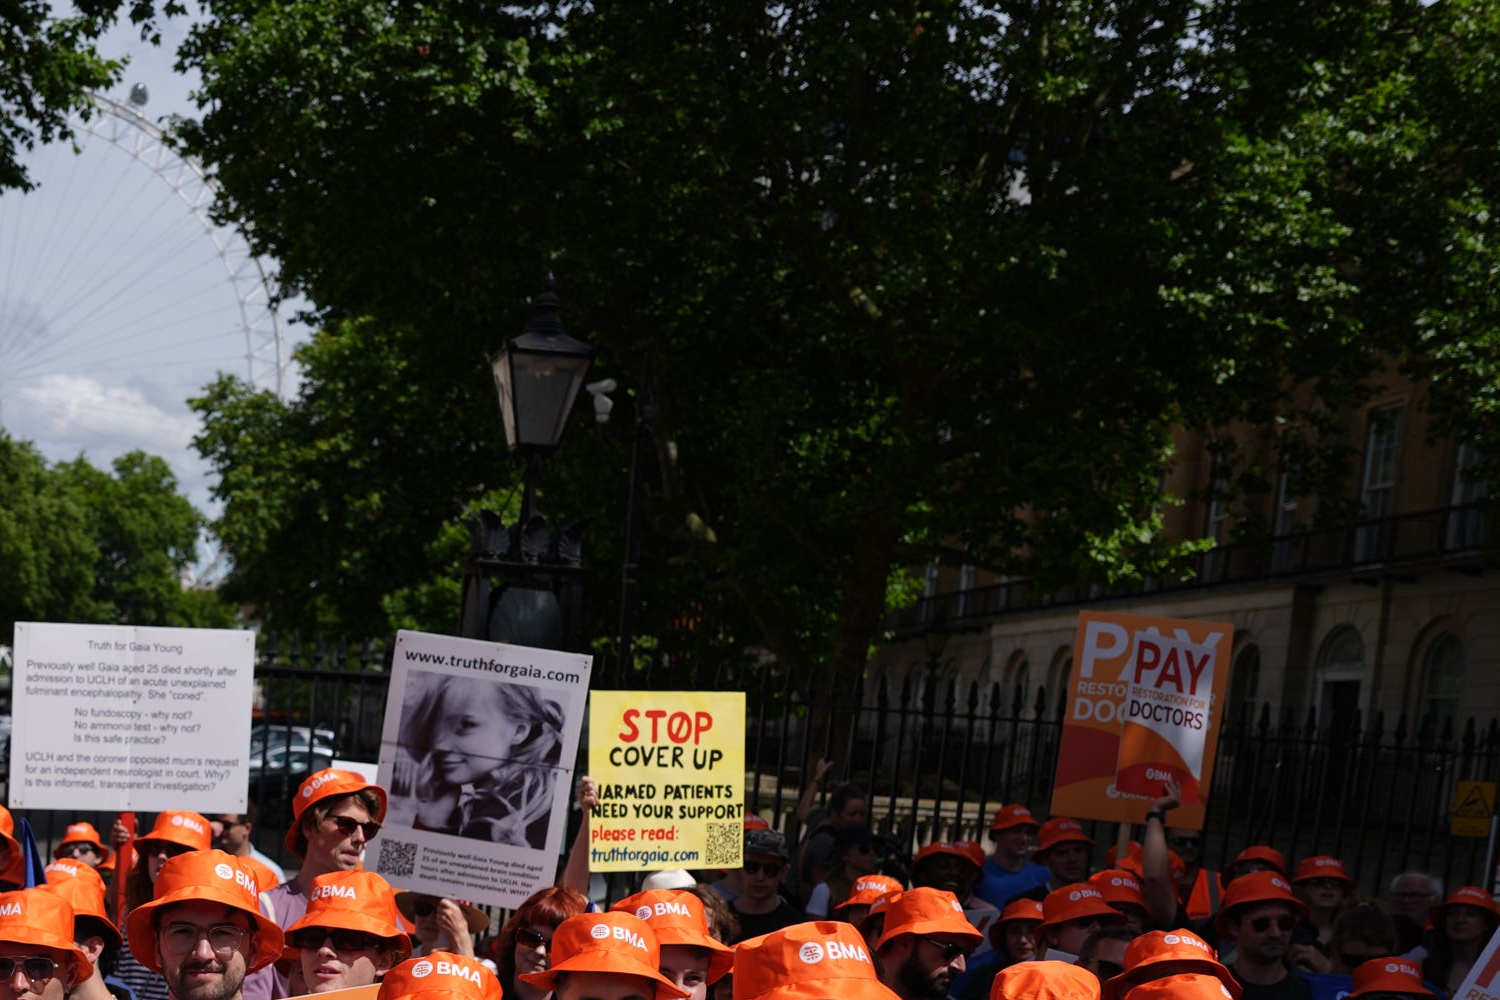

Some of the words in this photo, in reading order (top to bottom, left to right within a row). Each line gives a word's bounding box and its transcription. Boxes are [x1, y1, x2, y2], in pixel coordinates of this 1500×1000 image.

[88, 640, 111, 650] Truth
[114, 641, 126, 651] for
[129, 642, 150, 652] Gaia
[153, 643, 183, 655] Young
[26, 660, 75, 672] Previously
[77, 662, 96, 671] well
[99, 662, 120, 672] Gaia
[122, 664, 145, 675] aged
[147, 664, 159, 673] 25
[161, 664, 181, 675] died
[184, 665, 214, 677] shortly
[217, 667, 237, 677] after
[405, 651, 580, 684] www.truthforgaia.com
[1134, 640, 1211, 696] PAY
[26, 673, 73, 684] admission
[76, 675, 85, 684] to
[87, 675, 115, 685] UCLH
[117, 676, 127, 685] of
[142, 677, 168, 687] acute
[170, 678, 226, 690] unexplained
[25, 686, 68, 697] fulminant
[147, 690, 166, 699] She
[1133, 686, 1188, 706] RESTORATION
[1189, 699, 1205, 711] FOR
[75, 708, 88, 717] No
[90, 708, 141, 720] fundoscopy
[151, 711, 169, 721] why
[172, 711, 193, 719] not?
[1129, 700, 1203, 730] DOCTORS
[74, 721, 87, 730] No
[90, 722, 131, 731] ammonia
[134, 722, 151, 732] test
[159, 724, 177, 734] why
[181, 724, 201, 733] not?
[618, 709, 713, 745] STOP
[84, 734, 100, 743] this
[103, 735, 123, 744] safe
[125, 736, 166, 746] practice?
[25, 752, 54, 761] UCLH
[57, 753, 73, 762] and
[76, 753, 91, 762] the
[93, 755, 127, 764] coroner
[130, 755, 169, 767] opposed
[205, 757, 239, 768] request
[609, 746, 684, 768] COVER
[693, 748, 723, 771] UP
[311, 772, 339, 789] BMA
[664, 785, 733, 800] PATIENTS
[591, 803, 628, 818] NEED
[633, 804, 673, 819] YOUR
[679, 803, 744, 819] SUPPORT
[591, 825, 636, 843] please
[641, 825, 679, 842] read:
[591, 845, 699, 866] truthforgaia.com
[321, 885, 356, 899] BMA
[654, 903, 691, 918] BMA
[613, 926, 649, 952] BMA
[1181, 936, 1209, 952] BMA
[825, 941, 870, 965] BMA
[436, 962, 483, 988] BMA
